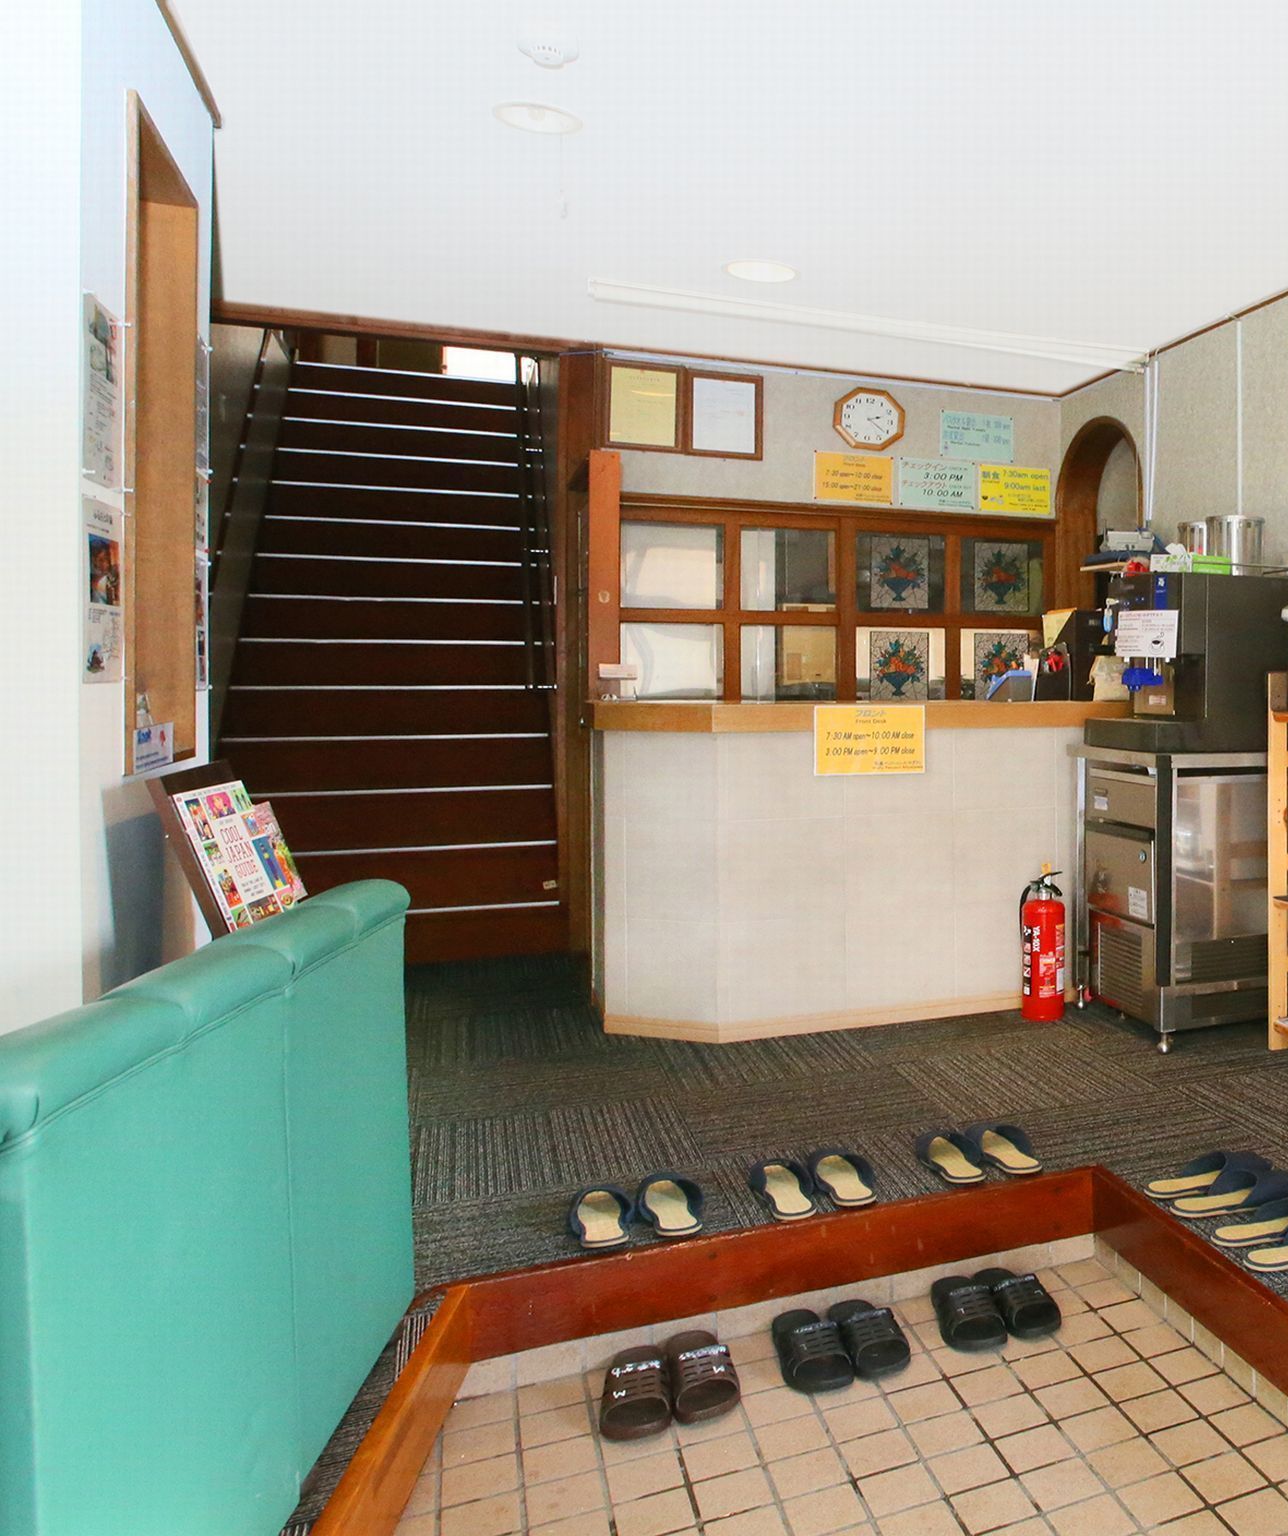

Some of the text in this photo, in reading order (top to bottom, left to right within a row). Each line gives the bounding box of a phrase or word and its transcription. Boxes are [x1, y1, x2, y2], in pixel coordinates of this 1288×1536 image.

[924, 472, 964, 481] 3:00 PM
[982, 471, 1000, 480] 朝食
[1033, 484, 1046, 492] last
[843, 731, 853, 740] AM
[891, 730, 901, 740] AM
[901, 730, 915, 740] close
[843, 747, 854, 756] PM
[891, 746, 901, 755] PM
[901, 746, 915, 755] close
[220, 825, 243, 845] COOL
[225, 841, 255, 863] JAPAN
[234, 859, 258, 879] GUIDE
[1032, 926, 1041, 952] YA-10X
